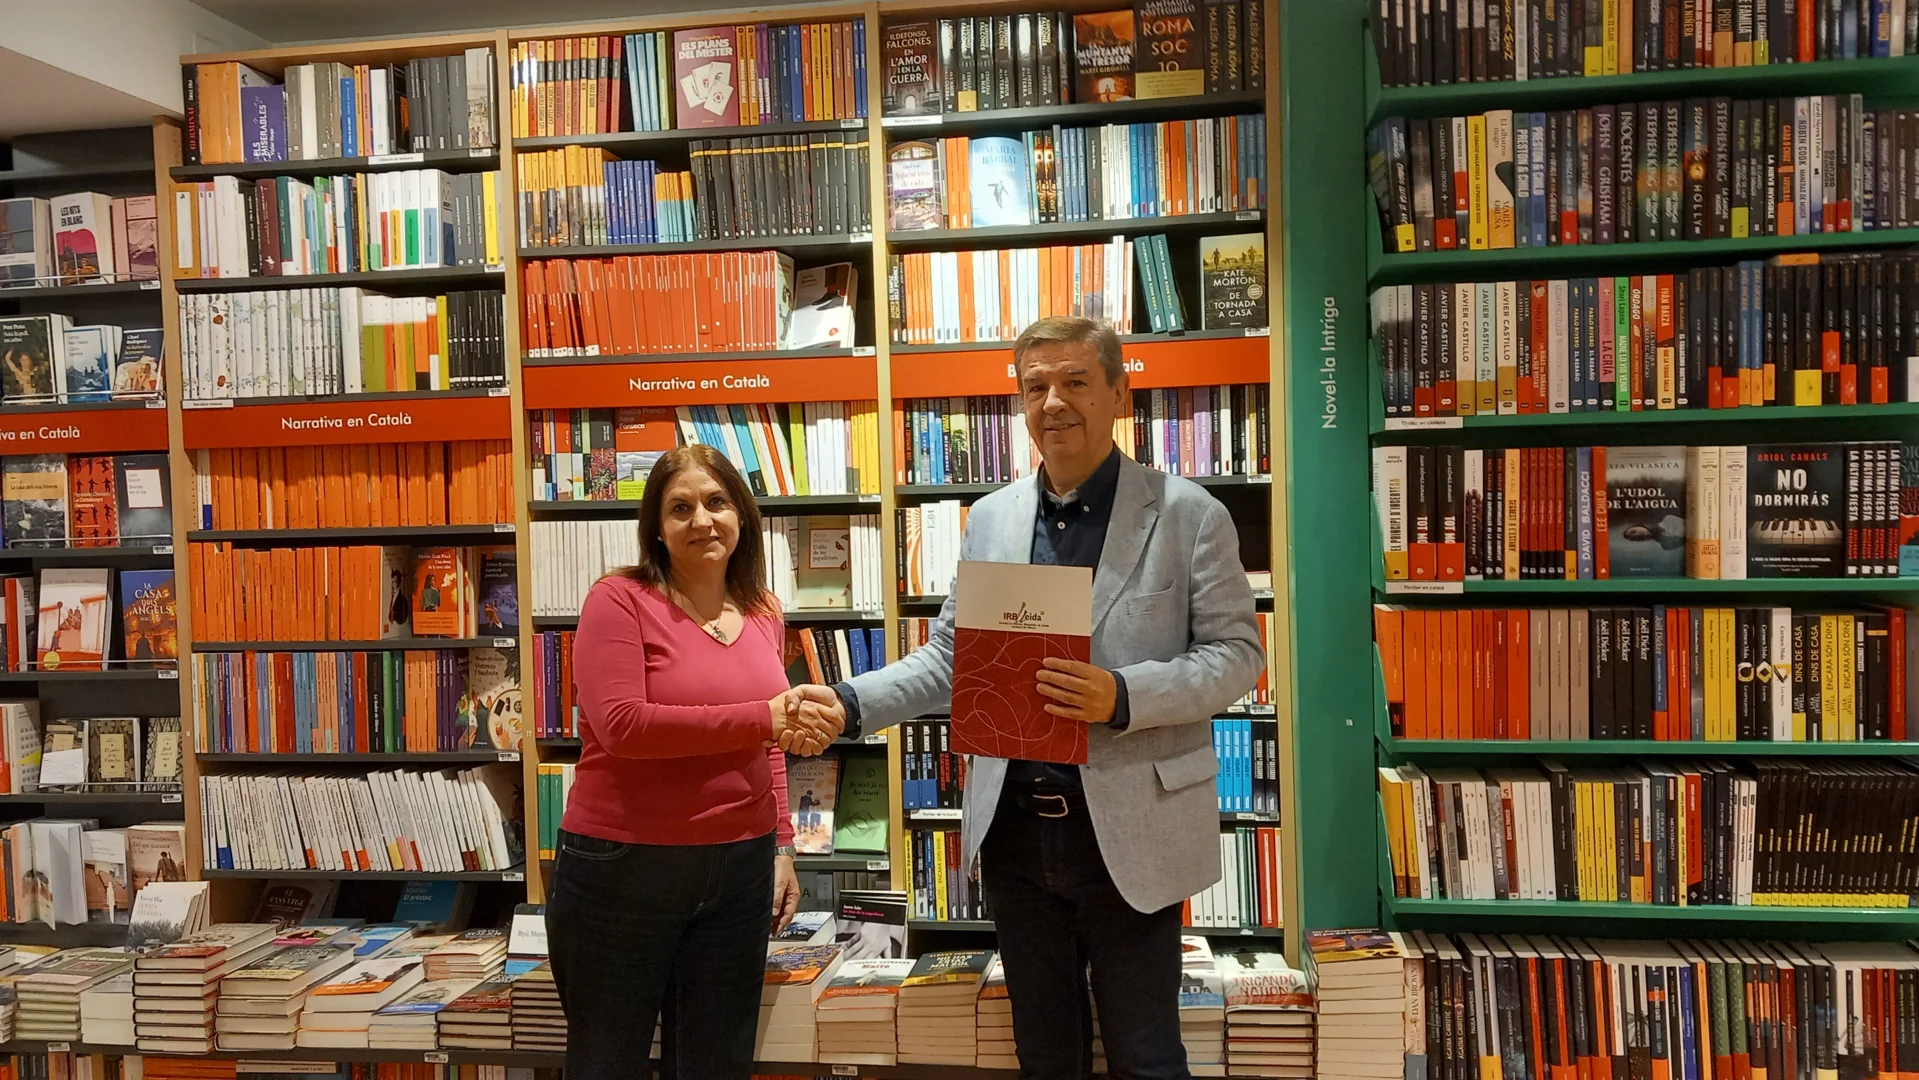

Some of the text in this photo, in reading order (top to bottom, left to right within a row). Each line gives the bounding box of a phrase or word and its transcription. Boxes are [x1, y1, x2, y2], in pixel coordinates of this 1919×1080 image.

[889, 30, 927, 40] ILDEFONSO
[1143, 18, 1195, 36] ROMA
[681, 39, 730, 51] ELS PLANS
[886, 37, 932, 49] FALCONES
[1151, 38, 1188, 55] SOC
[679, 47, 733, 60] DEL MISTER
[890, 54, 928, 67] L'AMOR
[1091, 55, 1130, 66] TRESOR
[911, 65, 922, 73] LA
[890, 73, 931, 85] GUERRA
[188, 105, 196, 150] GERMINAL
[259, 104, 267, 156] MISERABLES
[252, 142, 261, 157] ELS
[1517, 128, 1529, 165] PRESTON
[1621, 111, 1633, 183] INOCENTES
[1647, 107, 1658, 187] STEPHEN KING
[1667, 107, 1678, 187] STEPHEN KING
[1717, 102, 1728, 182] STEPHEN KING
[982, 155, 1019, 164] BARBAL
[1598, 113, 1612, 225] JOHN GRISHAM
[1517, 174, 1529, 198] CHILD
[1767, 154, 1775, 219] LA NIEVE INVISIBLE
[1502, 200, 1510, 229] MARÍA
[1213, 276, 1256, 287] MORTON
[1223, 269, 1245, 278] KATE
[1229, 292, 1240, 300] DE
[1618, 285, 1626, 302] Shari
[1214, 299, 1257, 309] TORNADA
[1218, 309, 1253, 318] A CASA
[1632, 288, 1641, 320] ÓRDAGO
[1660, 287, 1669, 327] IVÁN BAEZA
[1320, 296, 1339, 351] Intriga
[1618, 303, 1626, 325] Lapena
[1420, 291, 1428, 365] JAVIER CASTILLO
[1440, 289, 1448, 364] JAVIER CASTILLO
[1502, 287, 1510, 361] JAVIER CASTILLO
[1619, 335, 1627, 353] NADIE
[1602, 340, 1612, 376] LA CRÍA
[1619, 354, 1627, 362] LO
[629, 374, 770, 391] Narrativa en Català
[1619, 374, 1627, 393] VENIR
[281, 413, 412, 430] Narrativa en Català
[20, 431, 35, 440] en
[39, 425, 81, 439] Català
[1757, 452, 1828, 462] ORIOL CANALS
[1776, 468, 1807, 491] NO
[1616, 487, 1666, 497] L'UDOL
[1754, 491, 1830, 507] DORMIRÁS
[1595, 490, 1607, 532] LEE CHILD
[1625, 499, 1679, 509] L'AIGUA
[1581, 471, 1591, 560] DAVID BALDACCI
[1390, 517, 1401, 543] PRINCIPI
[1390, 544, 1401, 552] EL
[135, 589, 162, 599] CASA
[133, 603, 172, 615] ÀNGELS
[1601, 618, 1609, 662] Joël Dicker
[1622, 618, 1630, 662] Joël Dicker
[1641, 617, 1649, 661] Joël Dicker
[1655, 615, 1663, 655] Joël Dicker
[1794, 625, 1803, 683] DINS DE CASA
[1810, 625, 1819, 682] DINS DE CASA
[1410, 964, 1420, 1015] DAN BROWN
